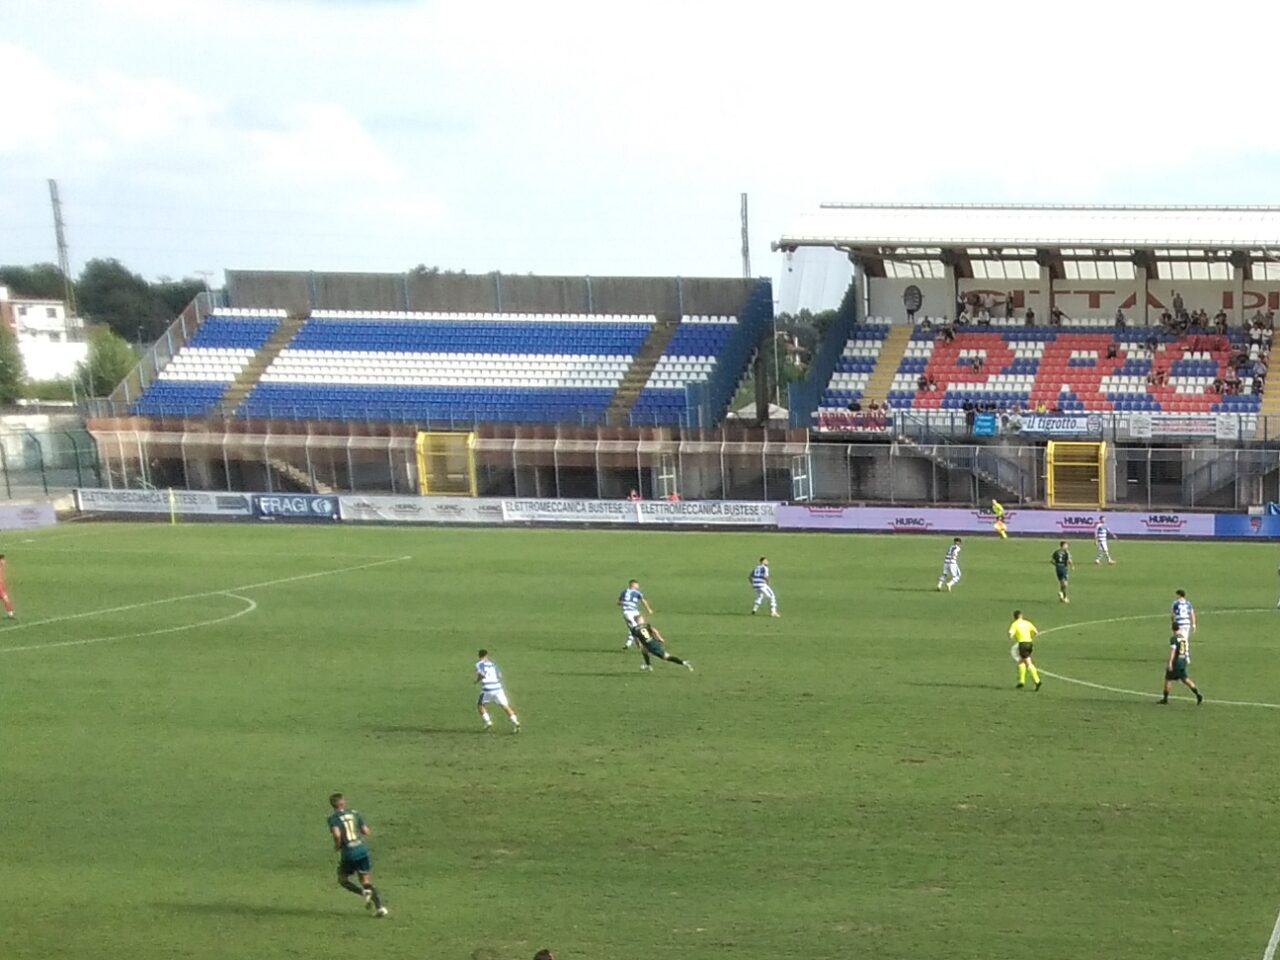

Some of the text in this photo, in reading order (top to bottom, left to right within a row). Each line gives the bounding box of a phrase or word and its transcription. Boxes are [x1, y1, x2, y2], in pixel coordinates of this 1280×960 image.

[261, 497, 308, 514] FRAGI
[505, 501, 587, 513] ELETTROMECCANICA
[588, 503, 624, 514] BUSTESE
[640, 503, 722, 515] ELETTROMECCANICA
[723, 504, 760, 516] BUSTESE
[895, 517, 925, 527] HUPAC
[1063, 516, 1094, 526] HUPAC
[1148, 515, 1179, 525] HUPAC
